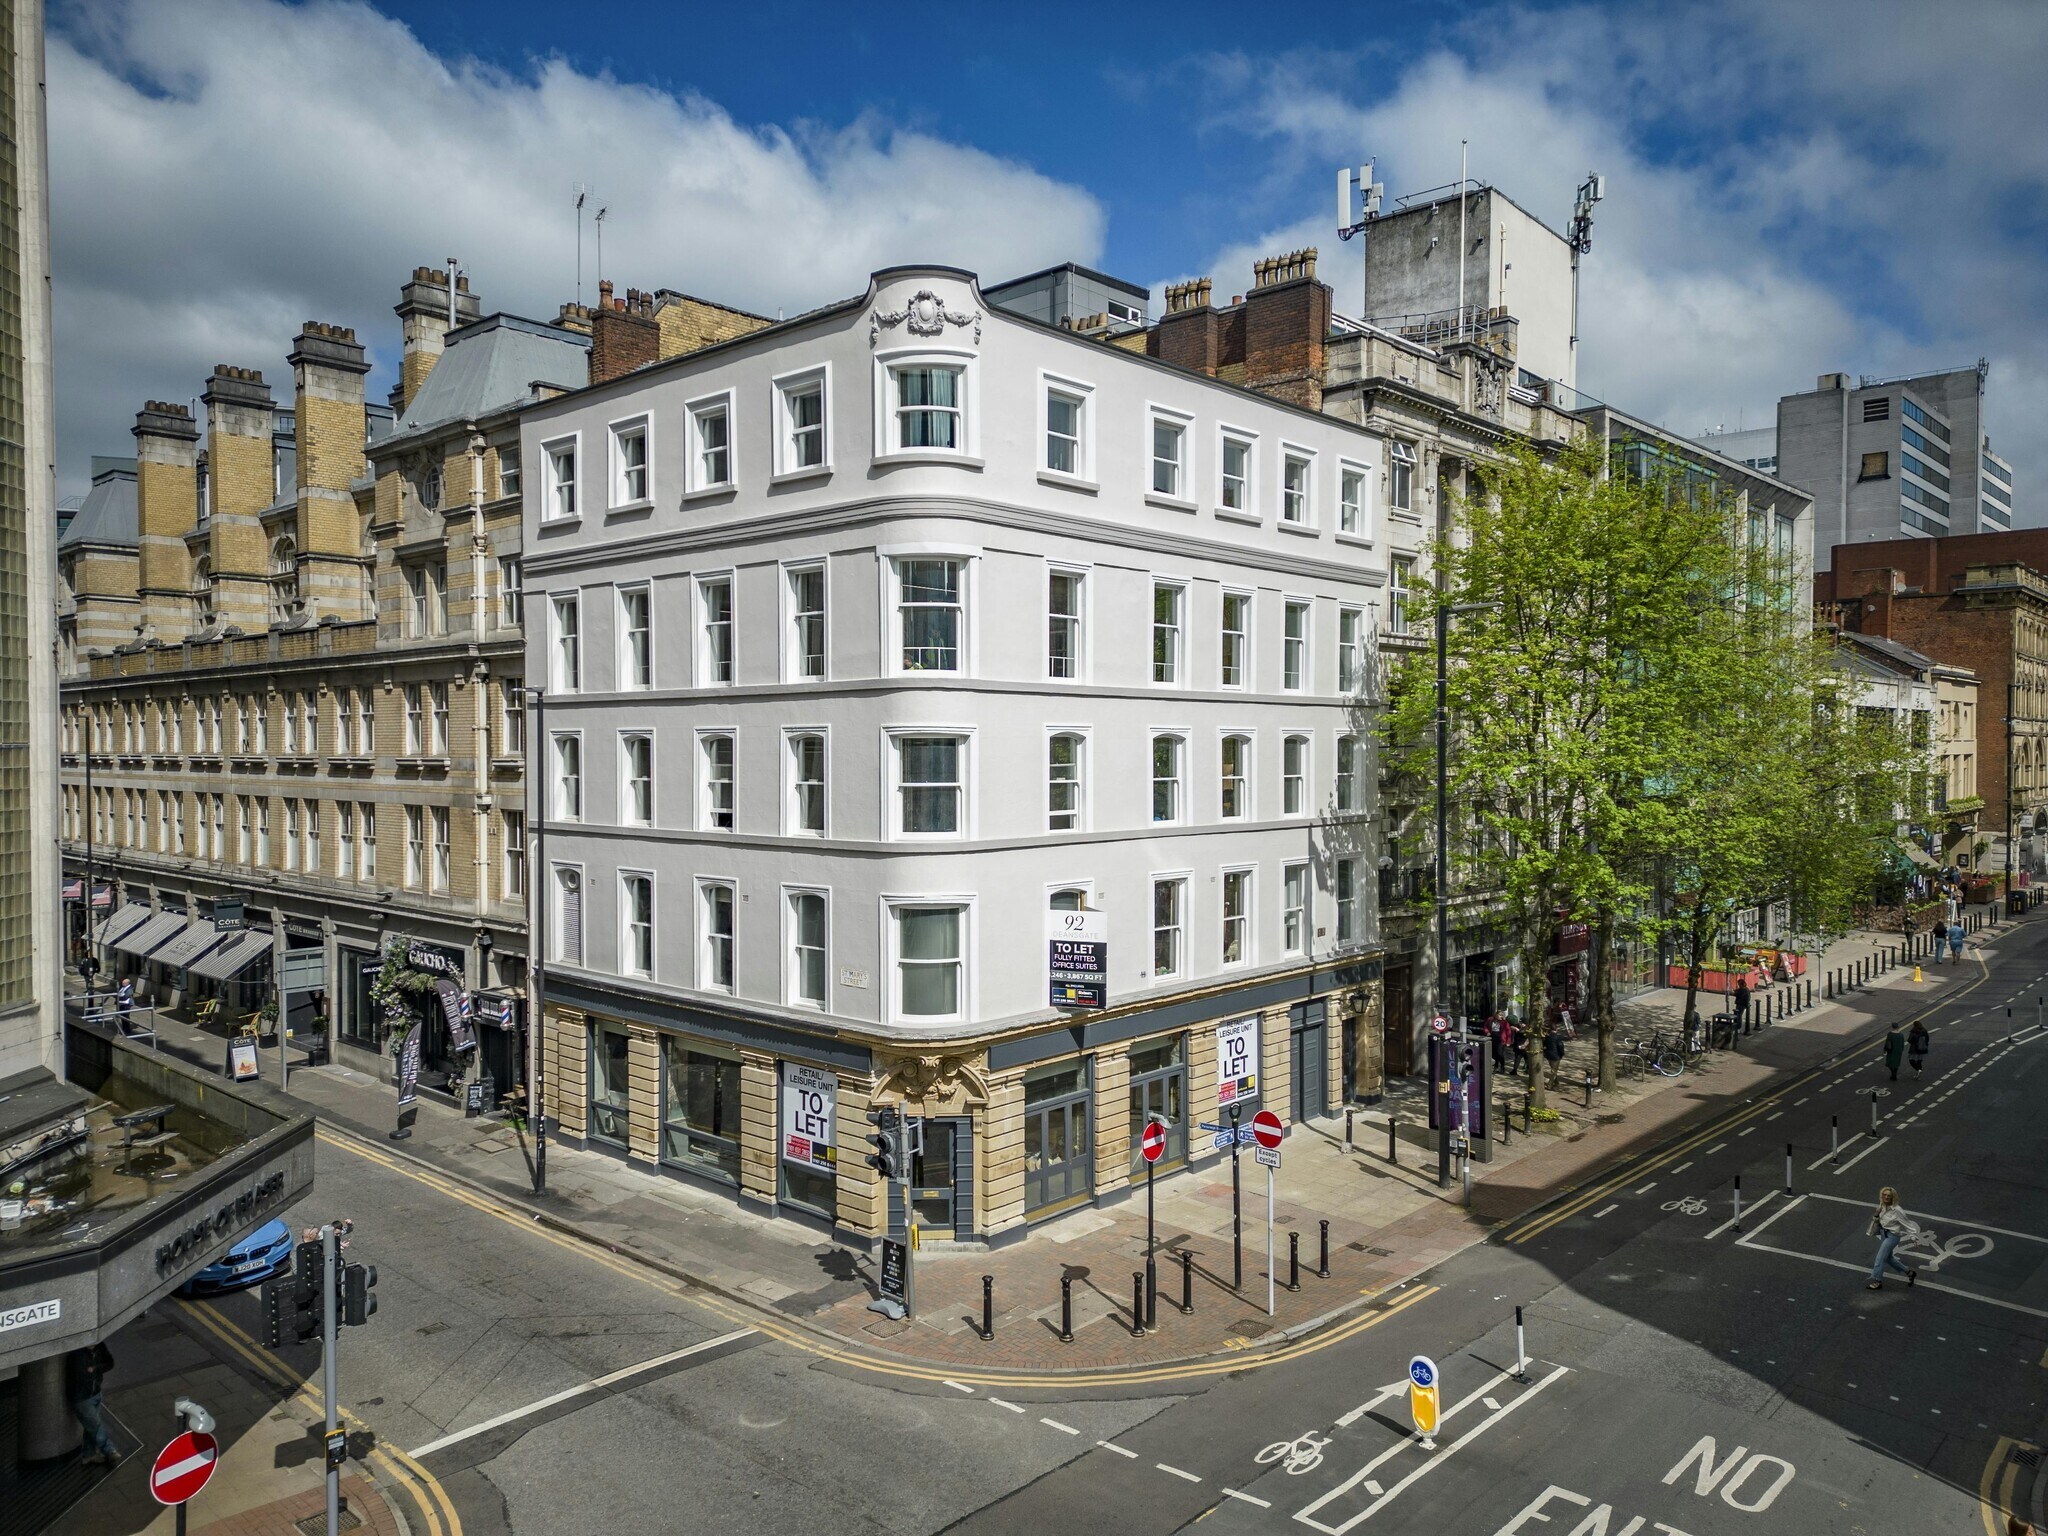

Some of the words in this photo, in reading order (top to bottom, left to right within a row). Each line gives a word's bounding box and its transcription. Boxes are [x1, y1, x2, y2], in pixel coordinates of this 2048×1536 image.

[217, 918, 241, 926] CÔTE
[1064, 914, 1085, 931] 92
[1052, 930, 1099, 940] DEANSGATE
[1056, 943, 1072, 953] TO
[1073, 943, 1095, 955] LET
[409, 950, 446, 971] GAUCHO
[1052, 961, 1075, 970] OFFICE
[1075, 962, 1098, 971] SUITES
[1054, 953, 1073, 962] FULLY
[1073, 954, 1096, 963] FITTED
[362, 966, 385, 974] GAUCHO
[1219, 1026, 1240, 1039] LEISURE
[1240, 1023, 1253, 1033] UNIT
[1435, 1020, 1446, 1028] 20
[1226, 1036, 1245, 1058] TO
[799, 1067, 824, 1080] RETAIL/
[1224, 1054, 1249, 1079] LET
[789, 1074, 817, 1089] LEISURE
[817, 1081, 834, 1093] UNIT
[798, 1088, 823, 1115] TO
[795, 1110, 828, 1139] LET
[1258, 1148, 1278, 1159] Except
[1259, 1156, 1277, 1166] cycles
[155, 1217, 212, 1271] HOUSE
[211, 1202, 237, 1233] OF
[235, 1171, 284, 1218] FRASER
[1661, 1435, 1796, 1513] NO
[1493, 1484, 1694, 1536] EN
